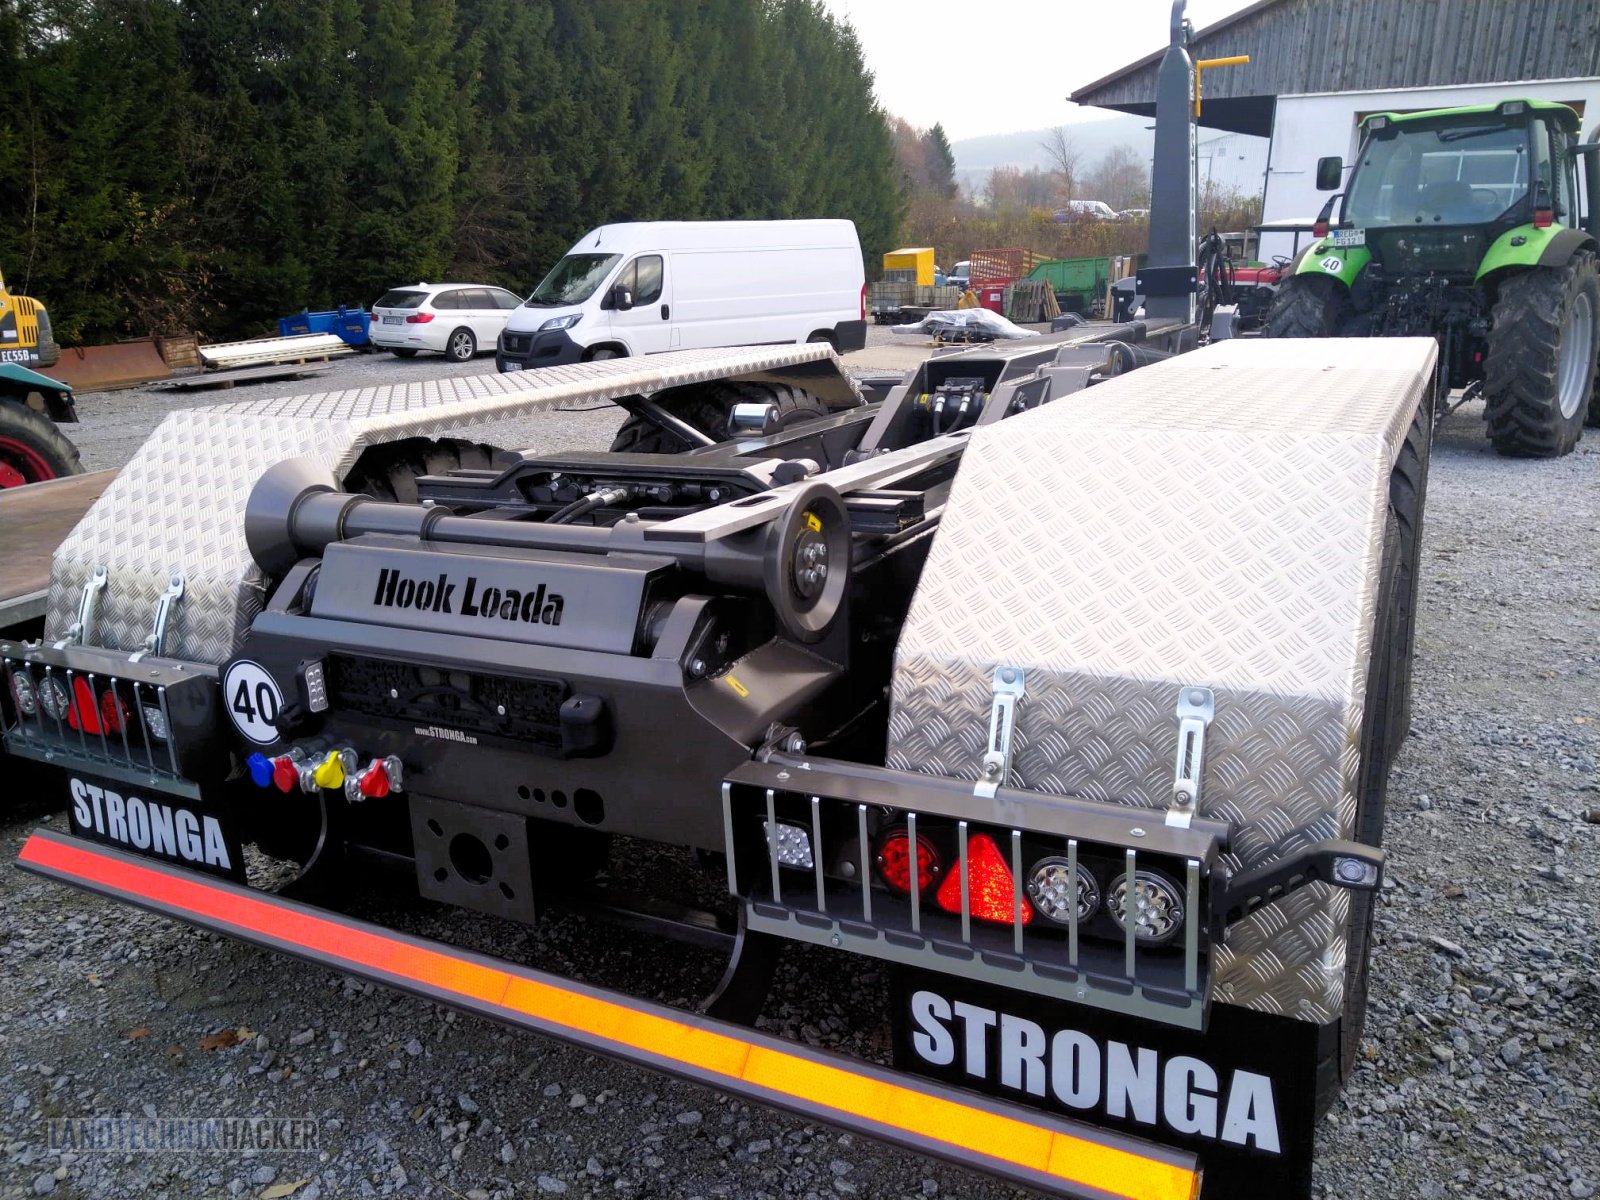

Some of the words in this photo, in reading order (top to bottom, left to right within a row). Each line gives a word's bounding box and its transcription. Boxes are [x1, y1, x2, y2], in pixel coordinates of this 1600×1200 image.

[1322, 258, 1340, 271] 40
[1, 349, 30, 362] EC55B
[373, 568, 456, 614] Hook
[460, 576, 565, 626] Loada
[233, 679, 280, 727] 40
[70, 777, 232, 870] STRONGA
[911, 990, 1282, 1154] STRONGA
